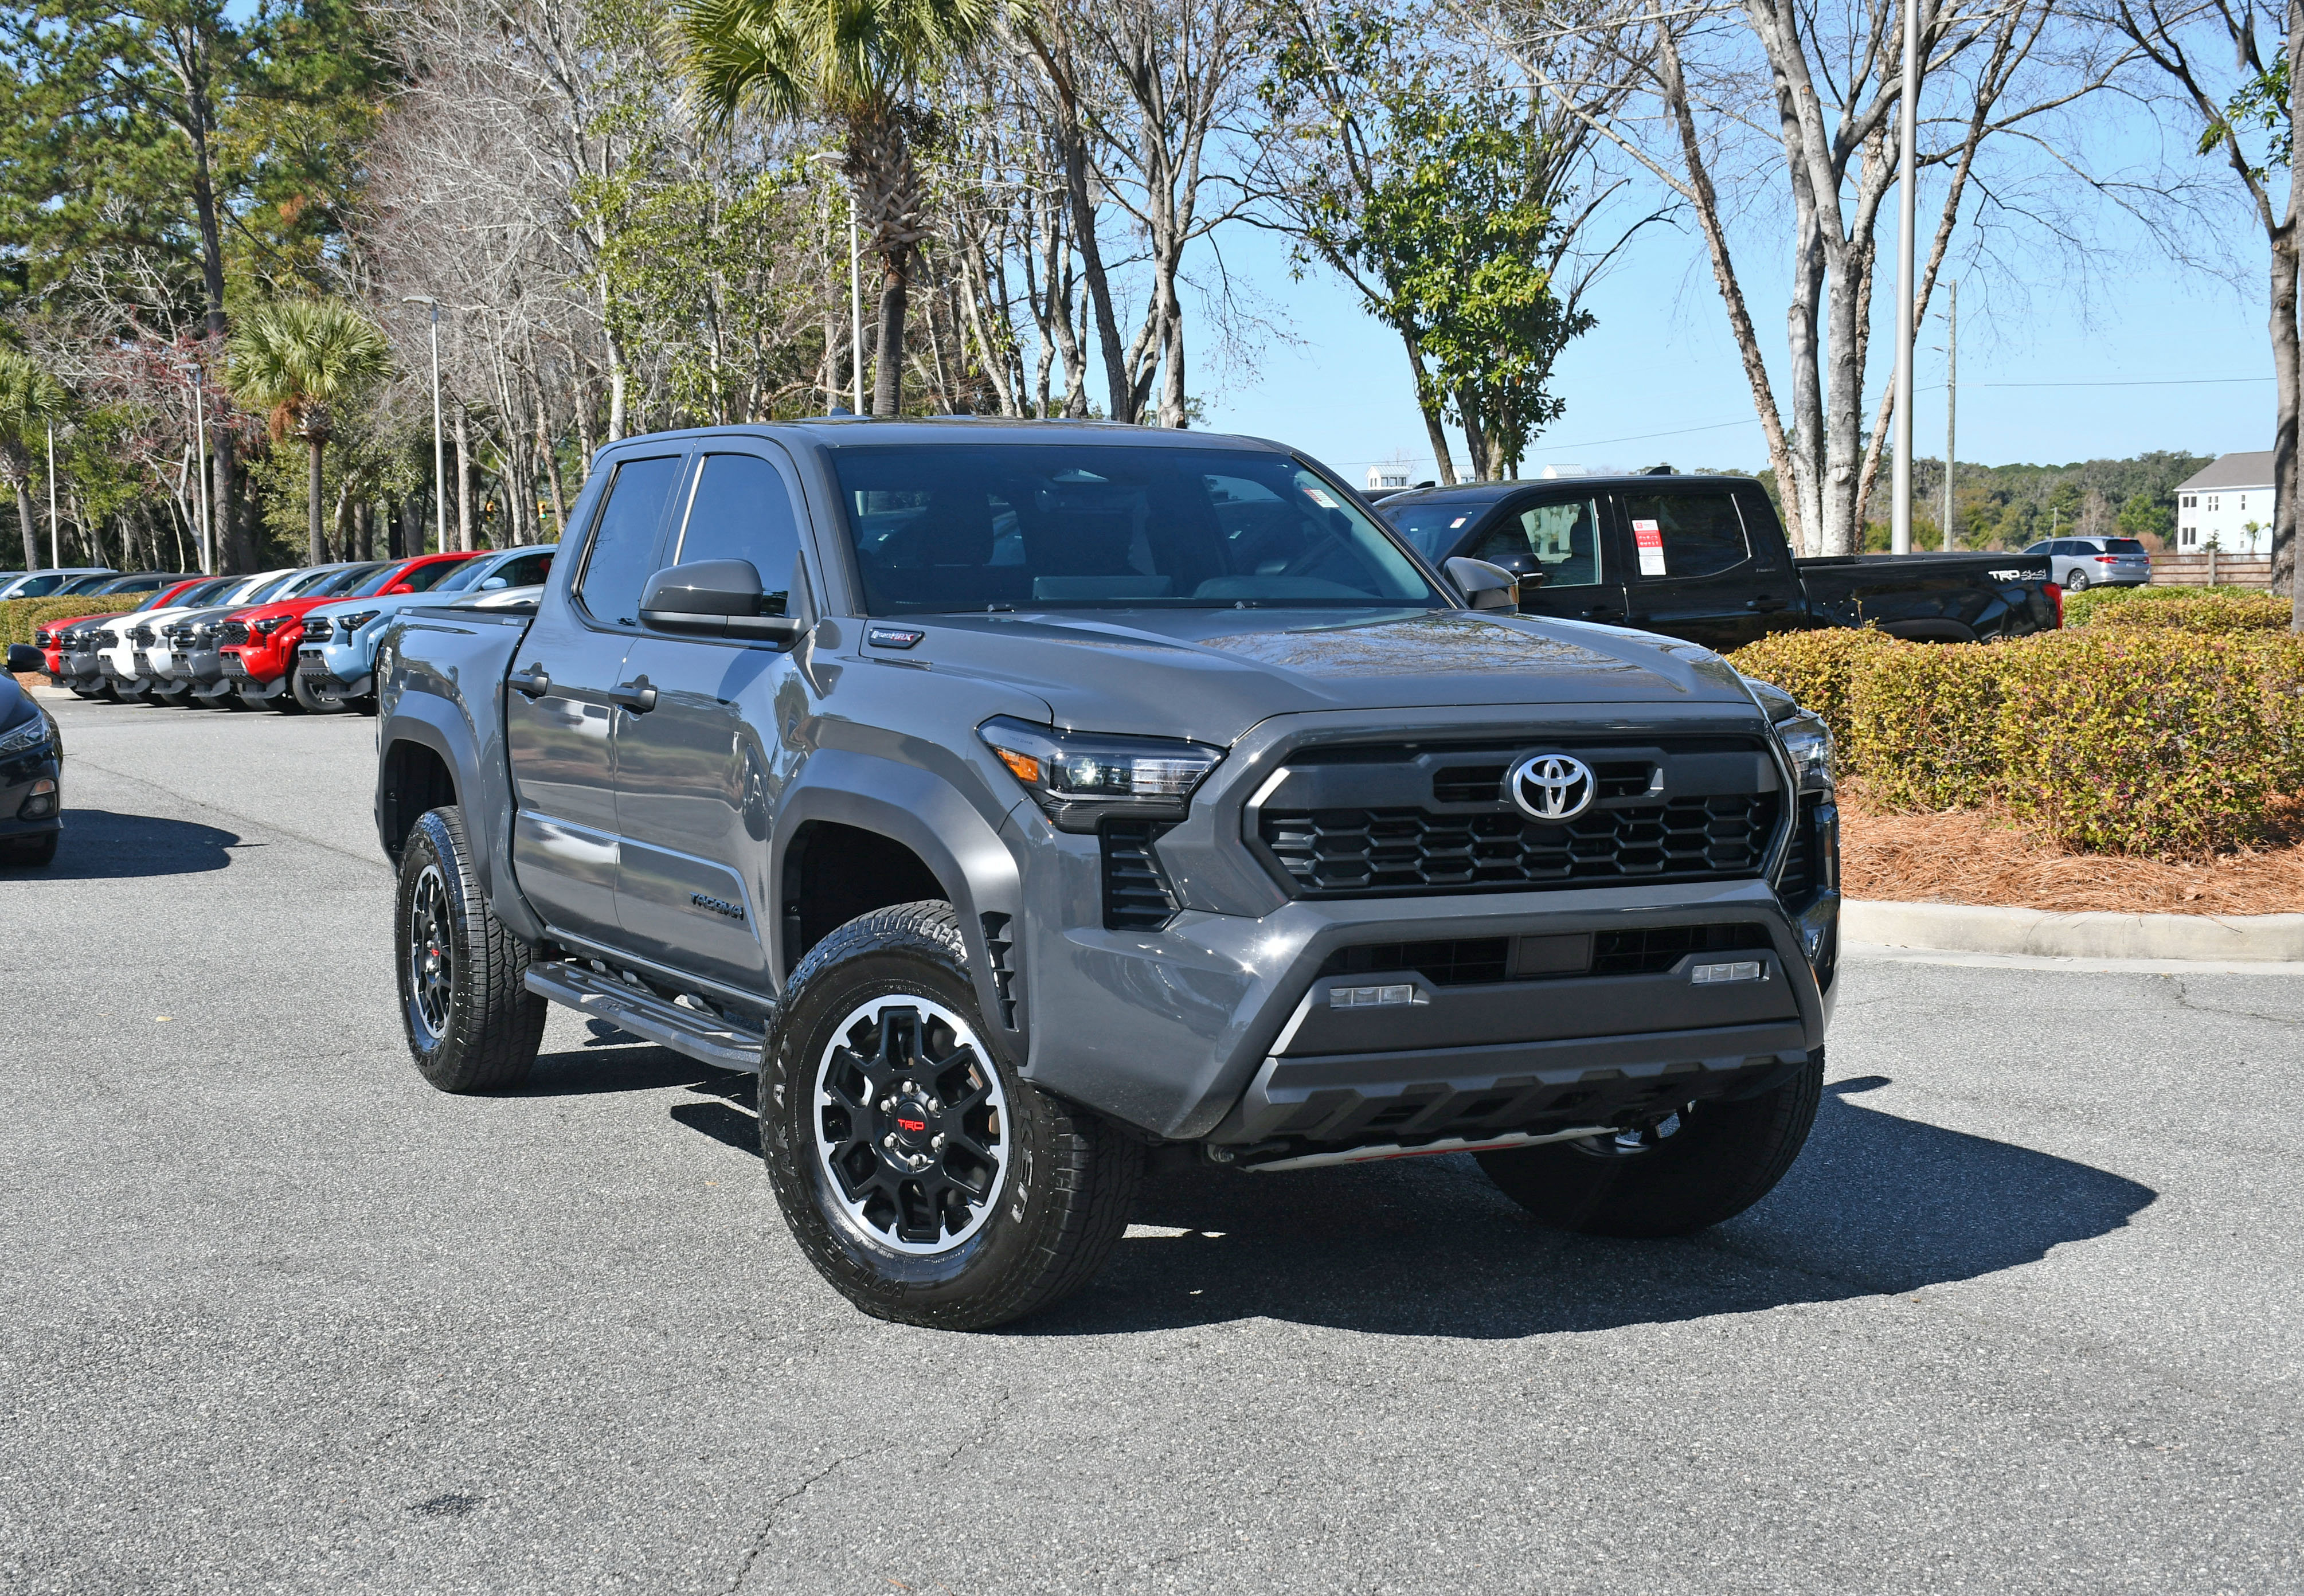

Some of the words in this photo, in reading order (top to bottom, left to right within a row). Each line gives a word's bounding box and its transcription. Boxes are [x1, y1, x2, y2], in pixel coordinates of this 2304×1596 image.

[1988, 570, 2020, 581] TRD
[689, 891, 744, 921] TACOMA
[897, 1118, 924, 1132] TRD
[1007, 1067, 1034, 1224] LKEN
